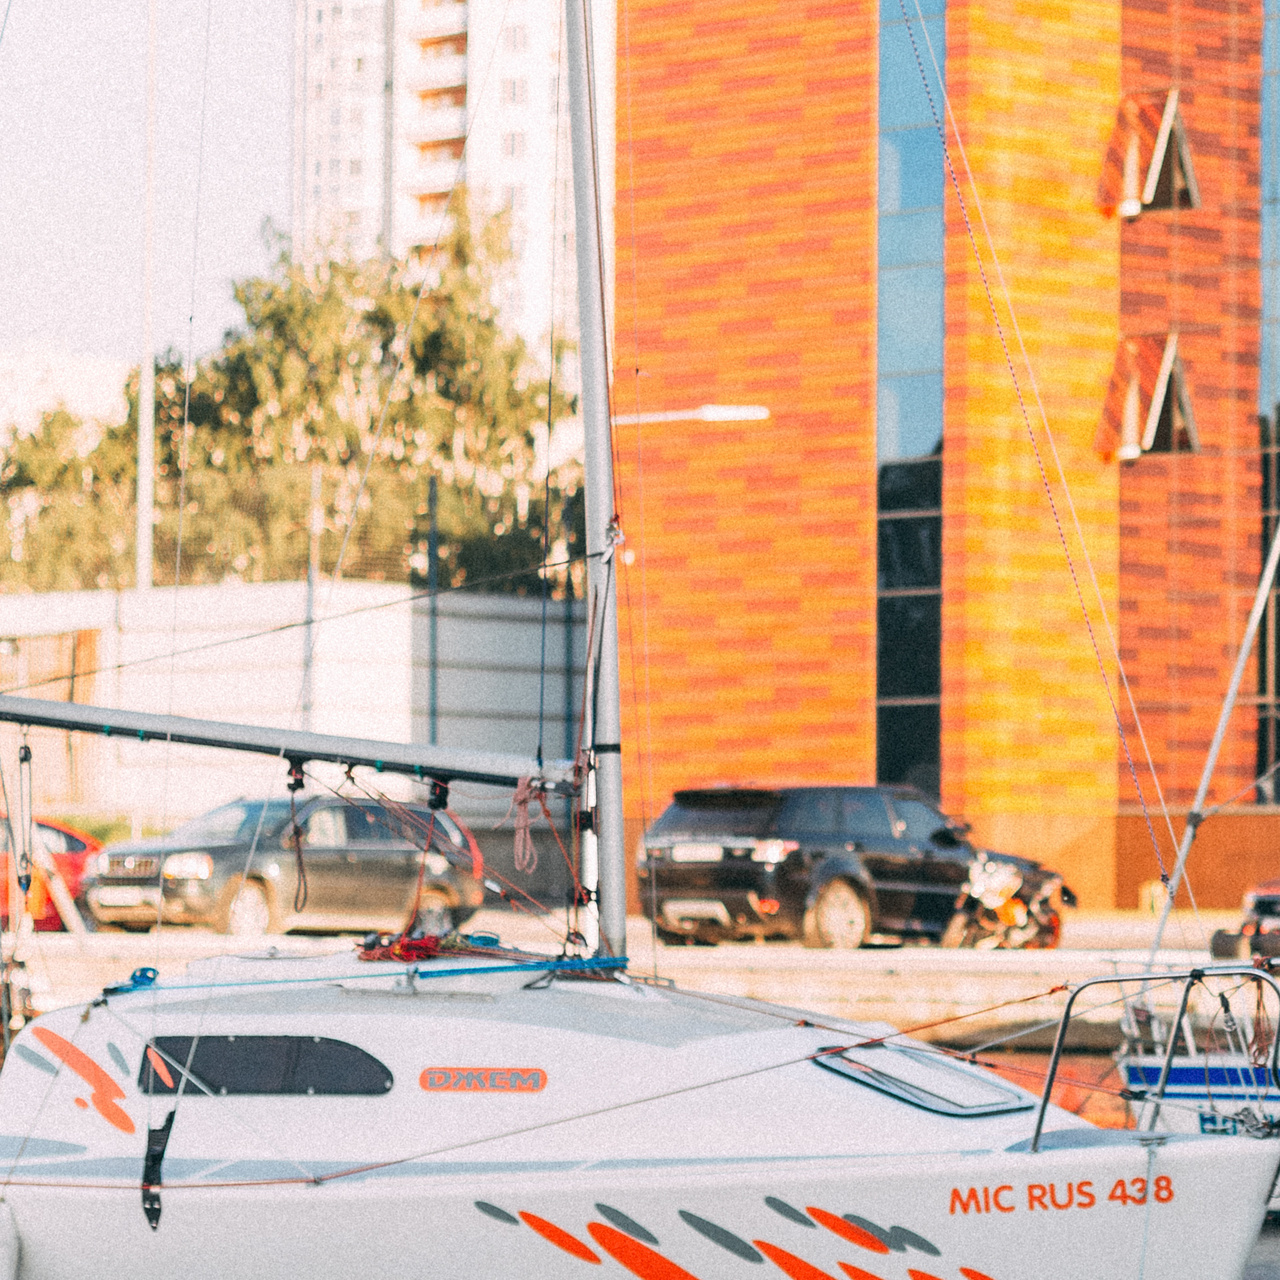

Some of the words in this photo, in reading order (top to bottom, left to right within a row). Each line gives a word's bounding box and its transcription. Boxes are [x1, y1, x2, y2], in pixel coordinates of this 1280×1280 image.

[949, 1184, 1016, 1215] MIC
[1027, 1180, 1097, 1211] RUS
[1107, 1175, 1175, 1206] 438
